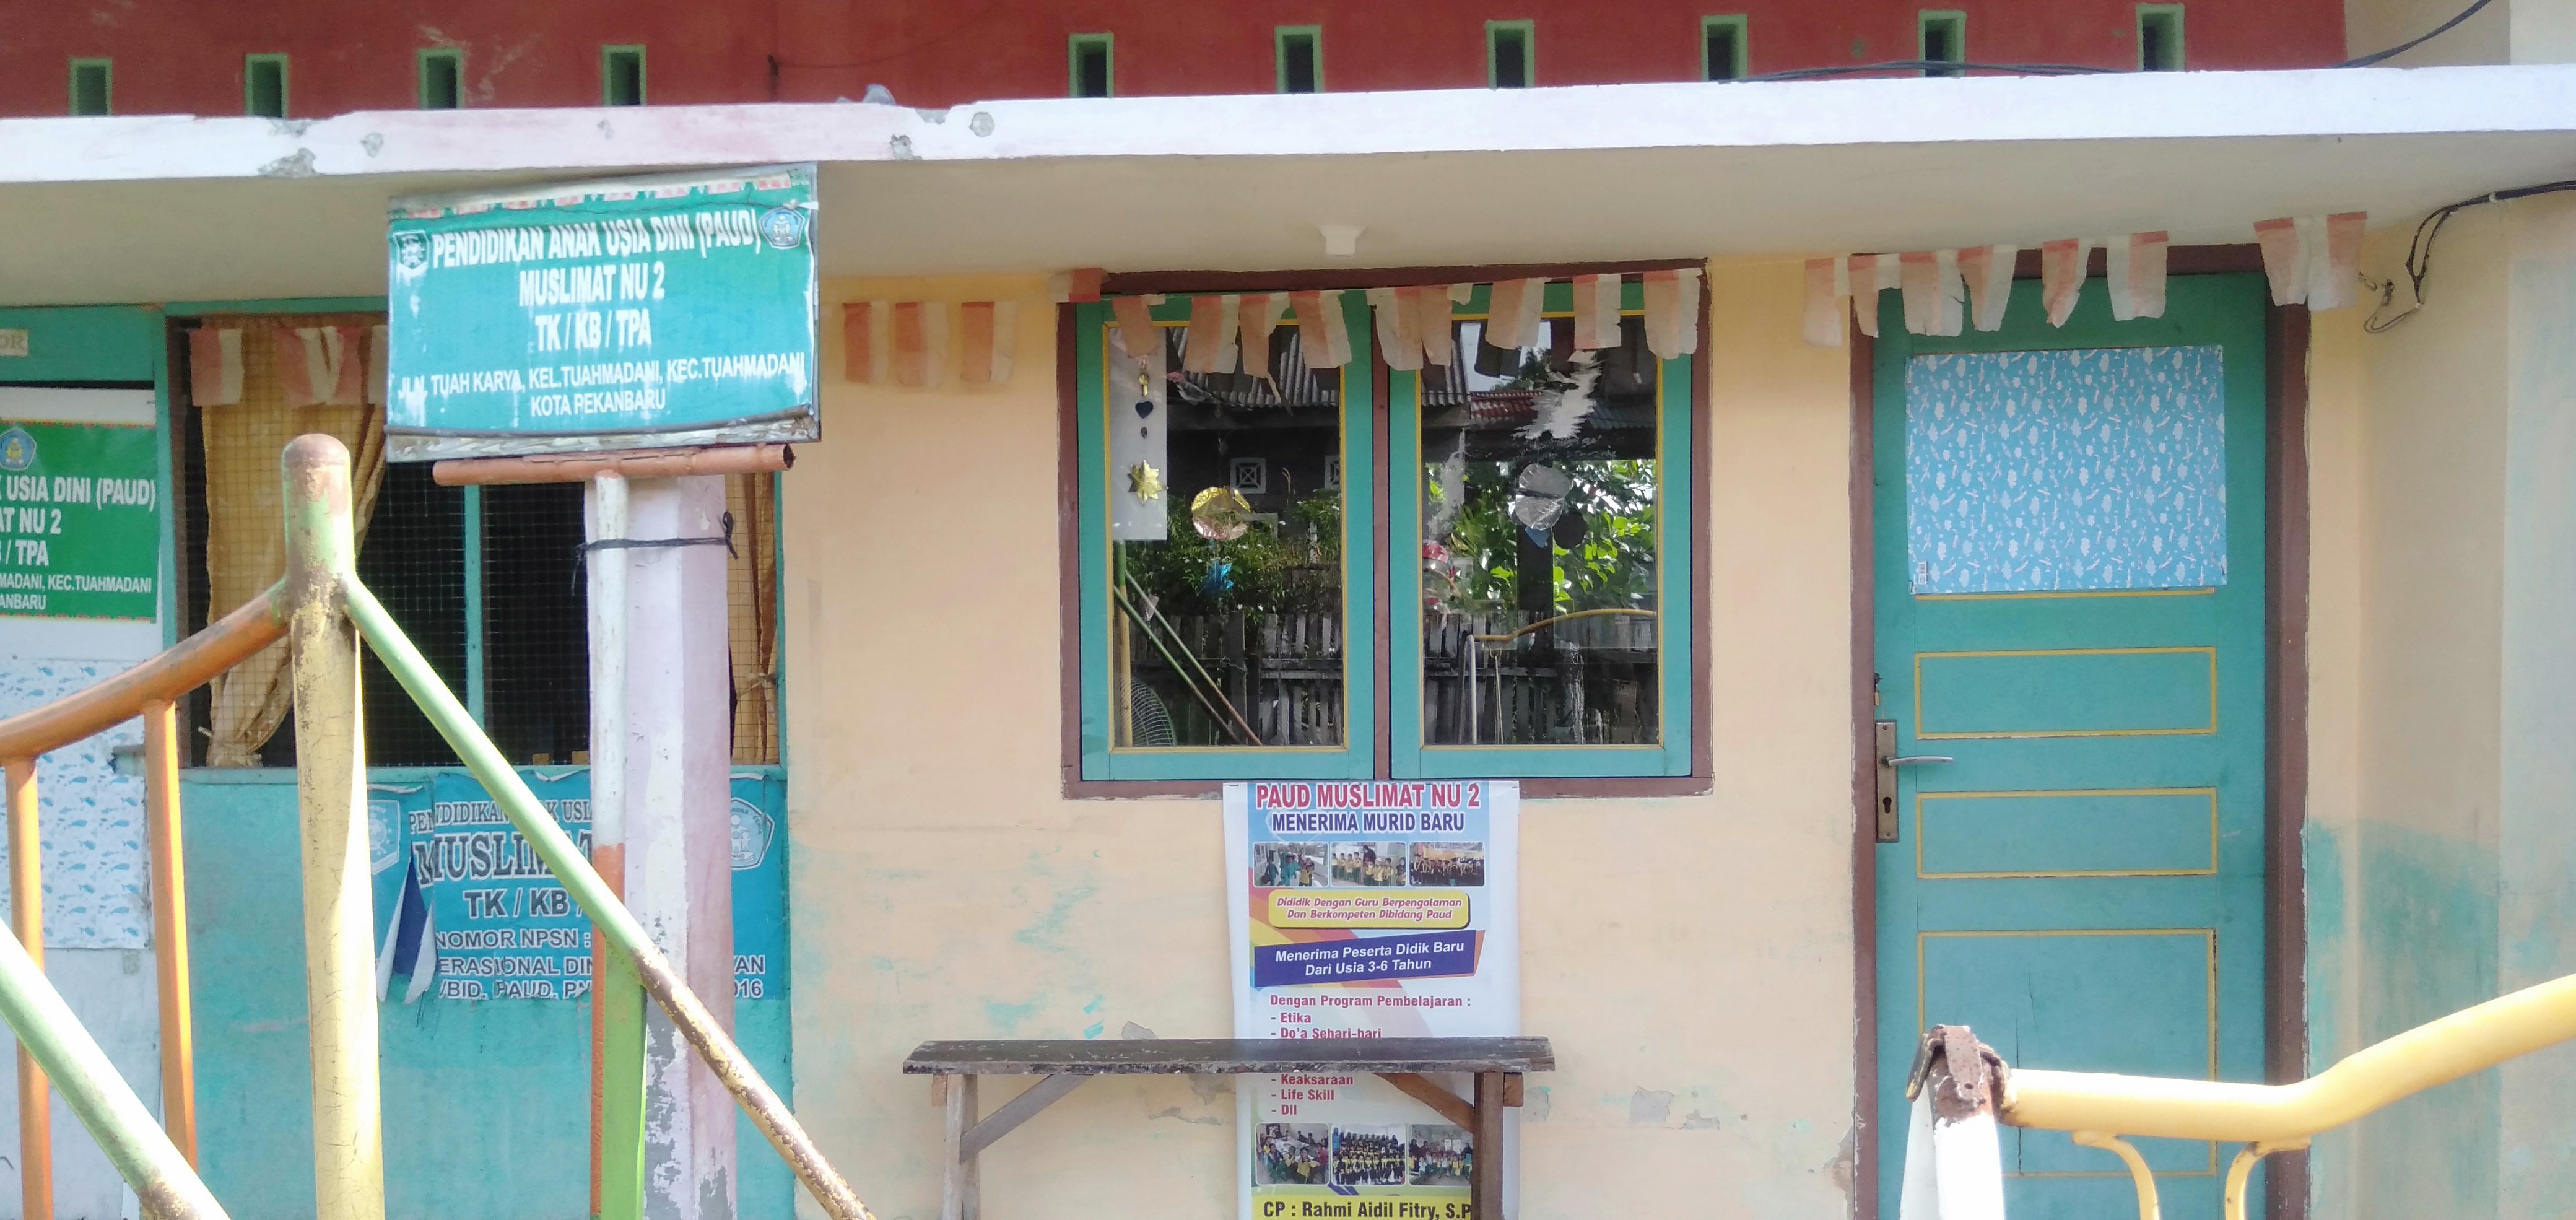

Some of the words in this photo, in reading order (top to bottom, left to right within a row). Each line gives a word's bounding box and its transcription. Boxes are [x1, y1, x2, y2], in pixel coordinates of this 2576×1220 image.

[432, 226, 544, 268] PENDIDIKAN
[549, 222, 601, 259] ANAK
[601, 218, 651, 257] USIA
[650, 214, 695, 252] DINI
[695, 209, 761, 258] (PAUD)
[519, 264, 617, 307] MUSLIMAT
[620, 262, 648, 300] NU
[652, 261, 665, 300] 2
[535, 313, 561, 351] TK
[565, 312, 572, 351] /
[575, 312, 602, 349] KB
[605, 310, 612, 348] /
[616, 308, 652, 347] TPA
[430, 372, 470, 395] TUAH
[472, 370, 526, 393] KARYA,
[666, 352, 805, 383] KEC.TUAHMADANI
[531, 394, 572, 417] KOTA
[573, 388, 666, 415] PEKANBARU
[6, 475, 49, 502] USIA
[54, 476, 91, 503] DINI
[96, 477, 155, 513] (PAUD)
[19, 507, 46, 534] NU
[50, 508, 62, 535] 2
[6, 539, 12, 565] /
[15, 539, 50, 567] TPA
[48, 575, 152, 594] KEC.TUAHMADANI
[1256, 784, 1310, 808] PAUD
[1316, 784, 1425, 807] MUSLIMAT
[1432, 784, 1461, 807] NU
[1468, 784, 1480, 807] 2
[1273, 813, 1359, 831] MENERIMA
[1363, 813, 1416, 831] MURID
[1421, 813, 1464, 831] BARU
[464, 889, 506, 917] TK
[513, 887, 523, 917] /
[531, 889, 569, 915] KB
[1277, 898, 1311, 907] Dididik
[1313, 898, 1351, 909] Dengan
[1355, 898, 1378, 907] Guru
[1382, 898, 1462, 909] Berpengalaman
[1287, 910, 1307, 918] Dan
[1310, 910, 1375, 921] Berkompeten
[1379, 909, 1423, 922] Dibidang
[1426, 910, 1452, 918] Paud
[435, 931, 515, 948] NOMOR
[521, 930, 577, 947] NPSN
[1276, 948, 1339, 962] Menerima
[1342, 946, 1391, 958] Peserta
[1396, 942, 1429, 955] Didik
[1433, 941, 1464, 953] Baru
[1305, 964, 1331, 975] Dari
[1335, 962, 1364, 974] Usia
[1368, 961, 1388, 972] 3-6
[1392, 957, 1432, 970] Tahun
[1270, 995, 1316, 1008] Dengan
[1320, 995, 1372, 1008] Program
[1377, 995, 1462, 1009] Pembelajaran
[1281, 1012, 1312, 1023] Etika
[1312, 1027, 1382, 1039] Sehari-hari
[1281, 1073, 1354, 1085] Keaksaraan
[1281, 1089, 1303, 1100] Life
[1307, 1089, 1334, 1100] Skill
[1263, 1201, 1286, 1217] CP
[1302, 1201, 1352, 1217] Rahmi
[1357, 1201, 1393, 1218] Aidil
[1399, 1201, 1440, 1220] Fitry,
